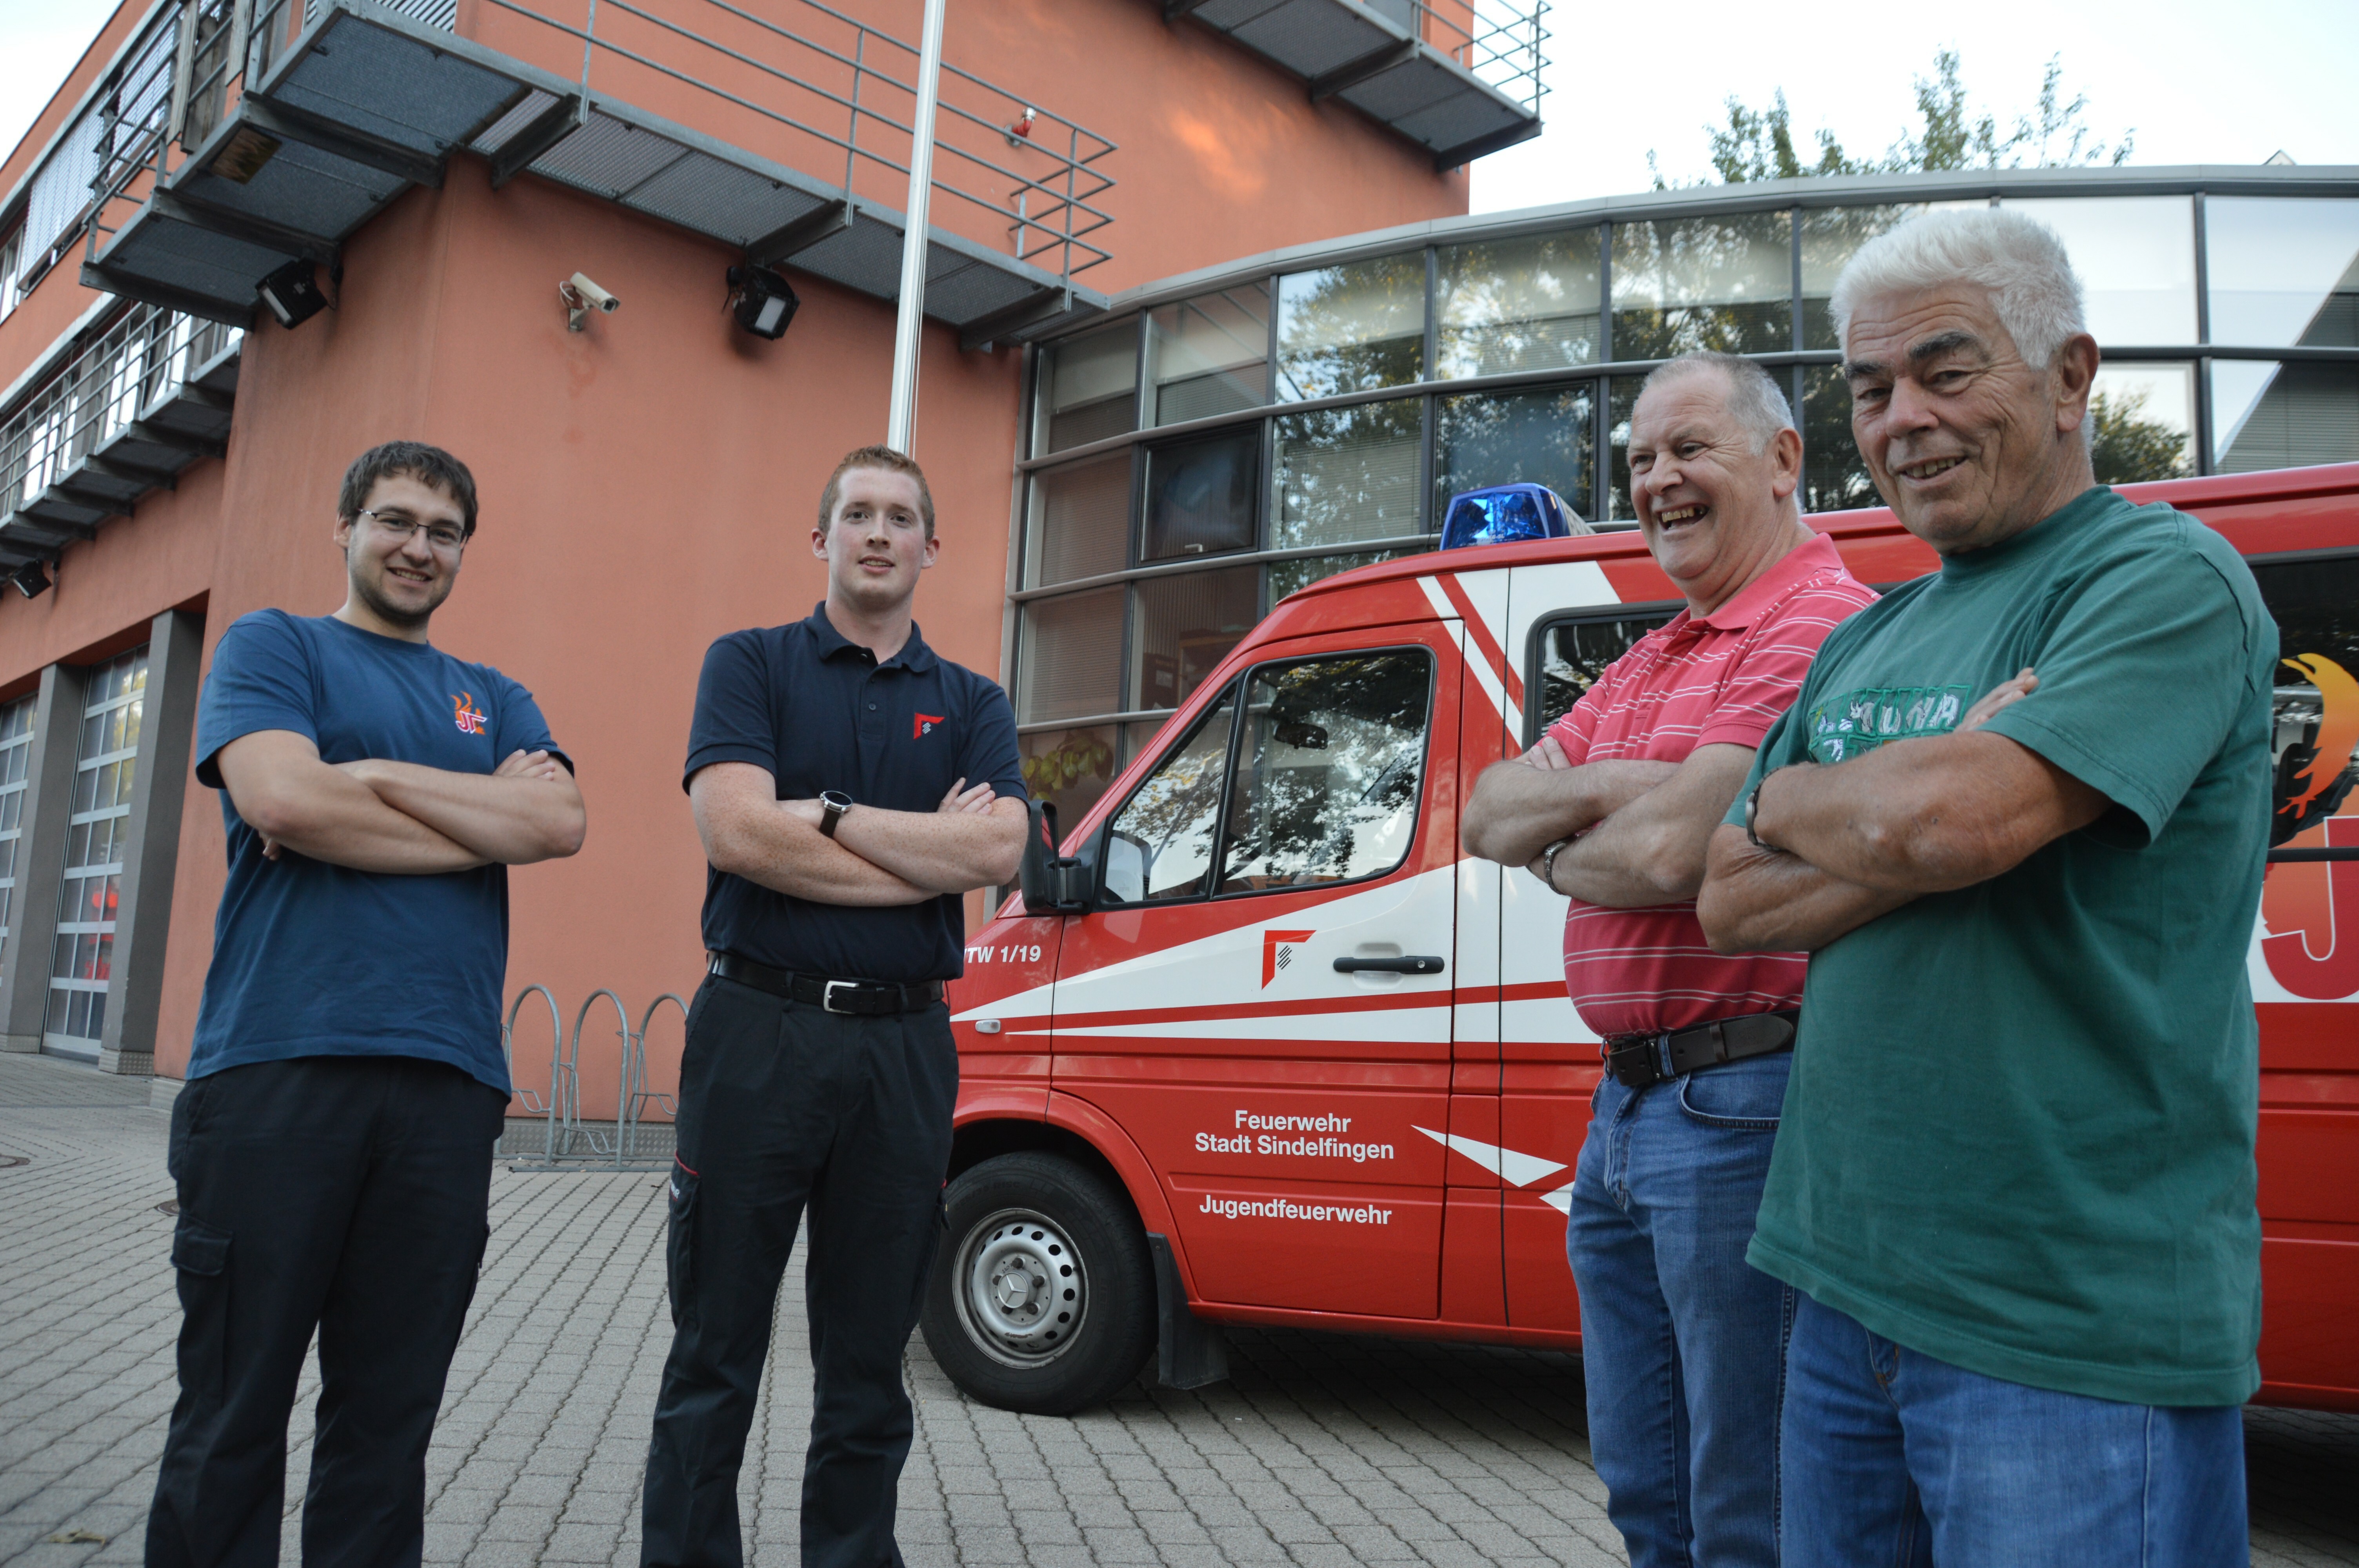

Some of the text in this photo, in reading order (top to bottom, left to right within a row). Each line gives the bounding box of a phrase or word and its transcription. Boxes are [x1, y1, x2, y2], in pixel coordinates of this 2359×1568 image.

[964, 945, 1041, 963] TW 1/19
[1235, 1110, 1351, 1132] Feuerwehr
[1196, 1133, 1394, 1163] Stadt Sindelfingen
[1199, 1195, 1392, 1224] Jugendfeuerwehr
